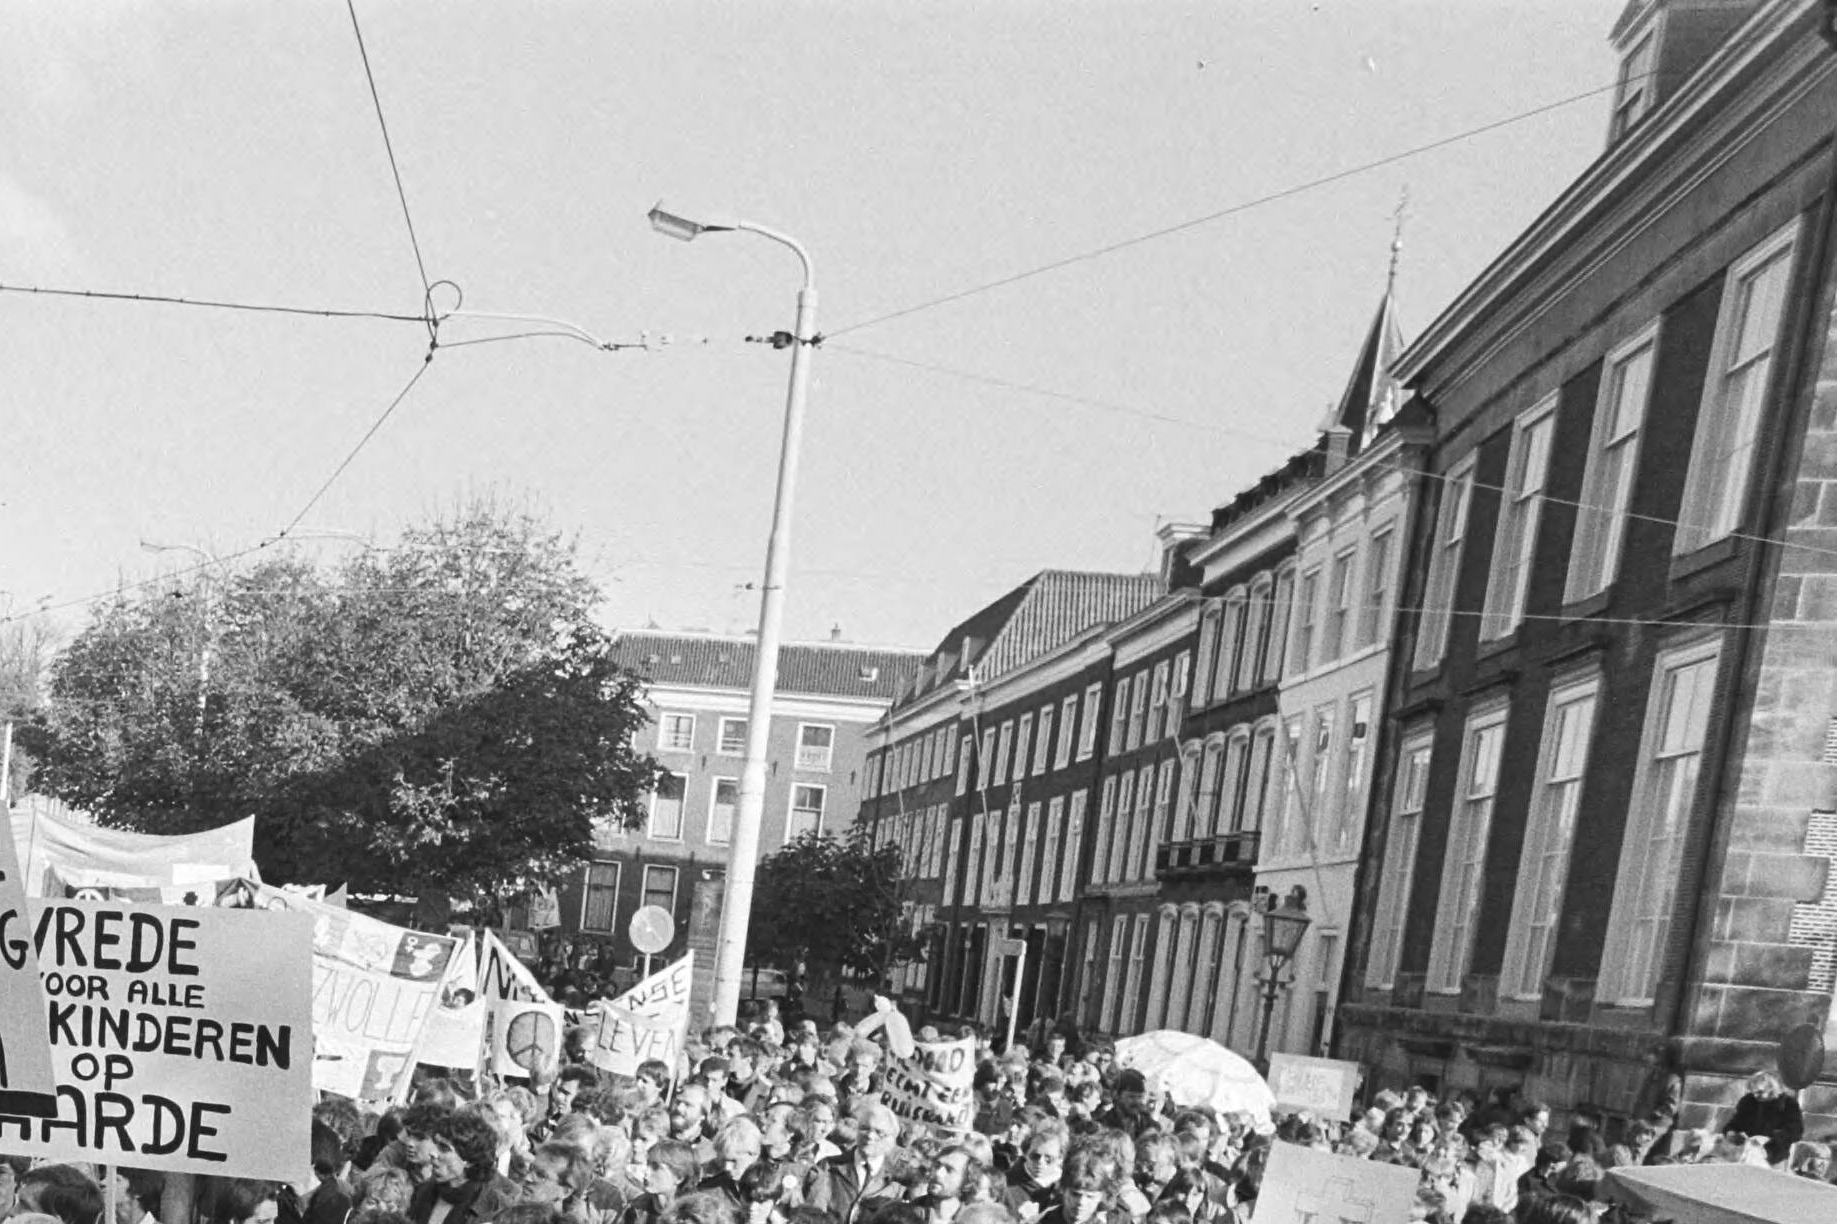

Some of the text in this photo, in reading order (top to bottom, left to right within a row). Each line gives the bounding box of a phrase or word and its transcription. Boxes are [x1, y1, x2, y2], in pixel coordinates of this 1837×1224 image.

[40, 972, 205, 1009] OOR ALLE
[49, 1000, 291, 1070] KINDEREN
[71, 1052, 134, 1091] OP
